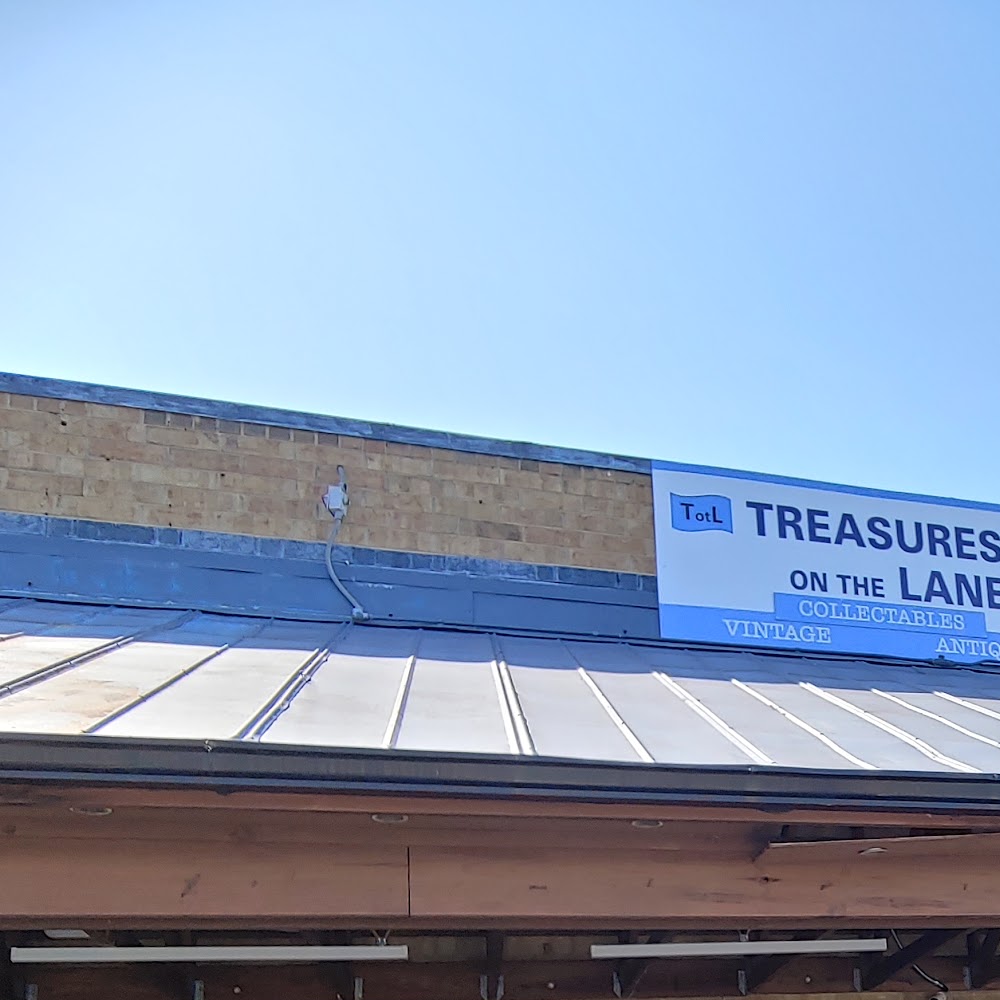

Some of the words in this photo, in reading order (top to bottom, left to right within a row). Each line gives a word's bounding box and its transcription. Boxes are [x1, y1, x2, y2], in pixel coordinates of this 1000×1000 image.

[680, 502, 723, 524] TotL
[790, 570, 828, 592] ON
[836, 574, 885, 598] THE
[798, 599, 965, 630] COLLECTABLES
[722, 618, 832, 644] VINTAGE
